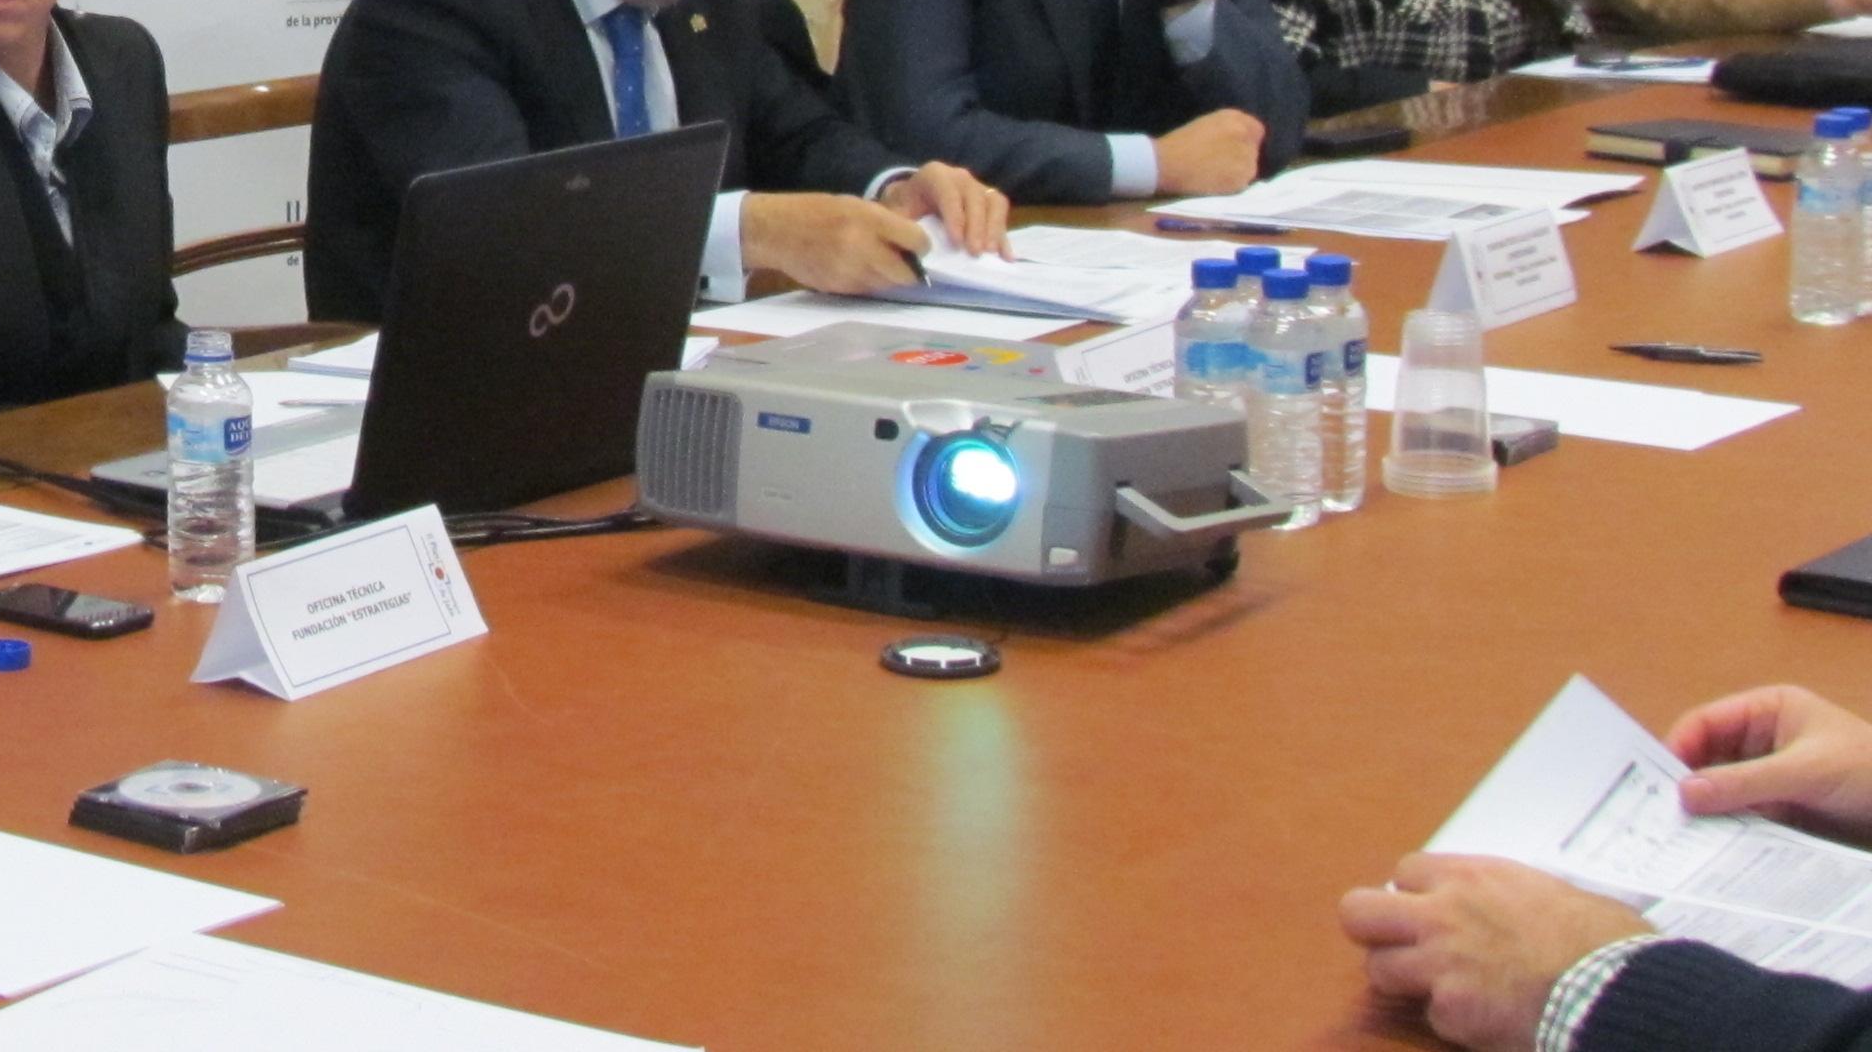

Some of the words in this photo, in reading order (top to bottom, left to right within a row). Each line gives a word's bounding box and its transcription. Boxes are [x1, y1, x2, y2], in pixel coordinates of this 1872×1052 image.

[286, 15, 299, 27] de
[302, 15, 311, 27] la
[307, 593, 347, 615] OFICINA
[347, 580, 386, 604] TÉCNICA
[291, 615, 348, 641] FUNDACIÓN
